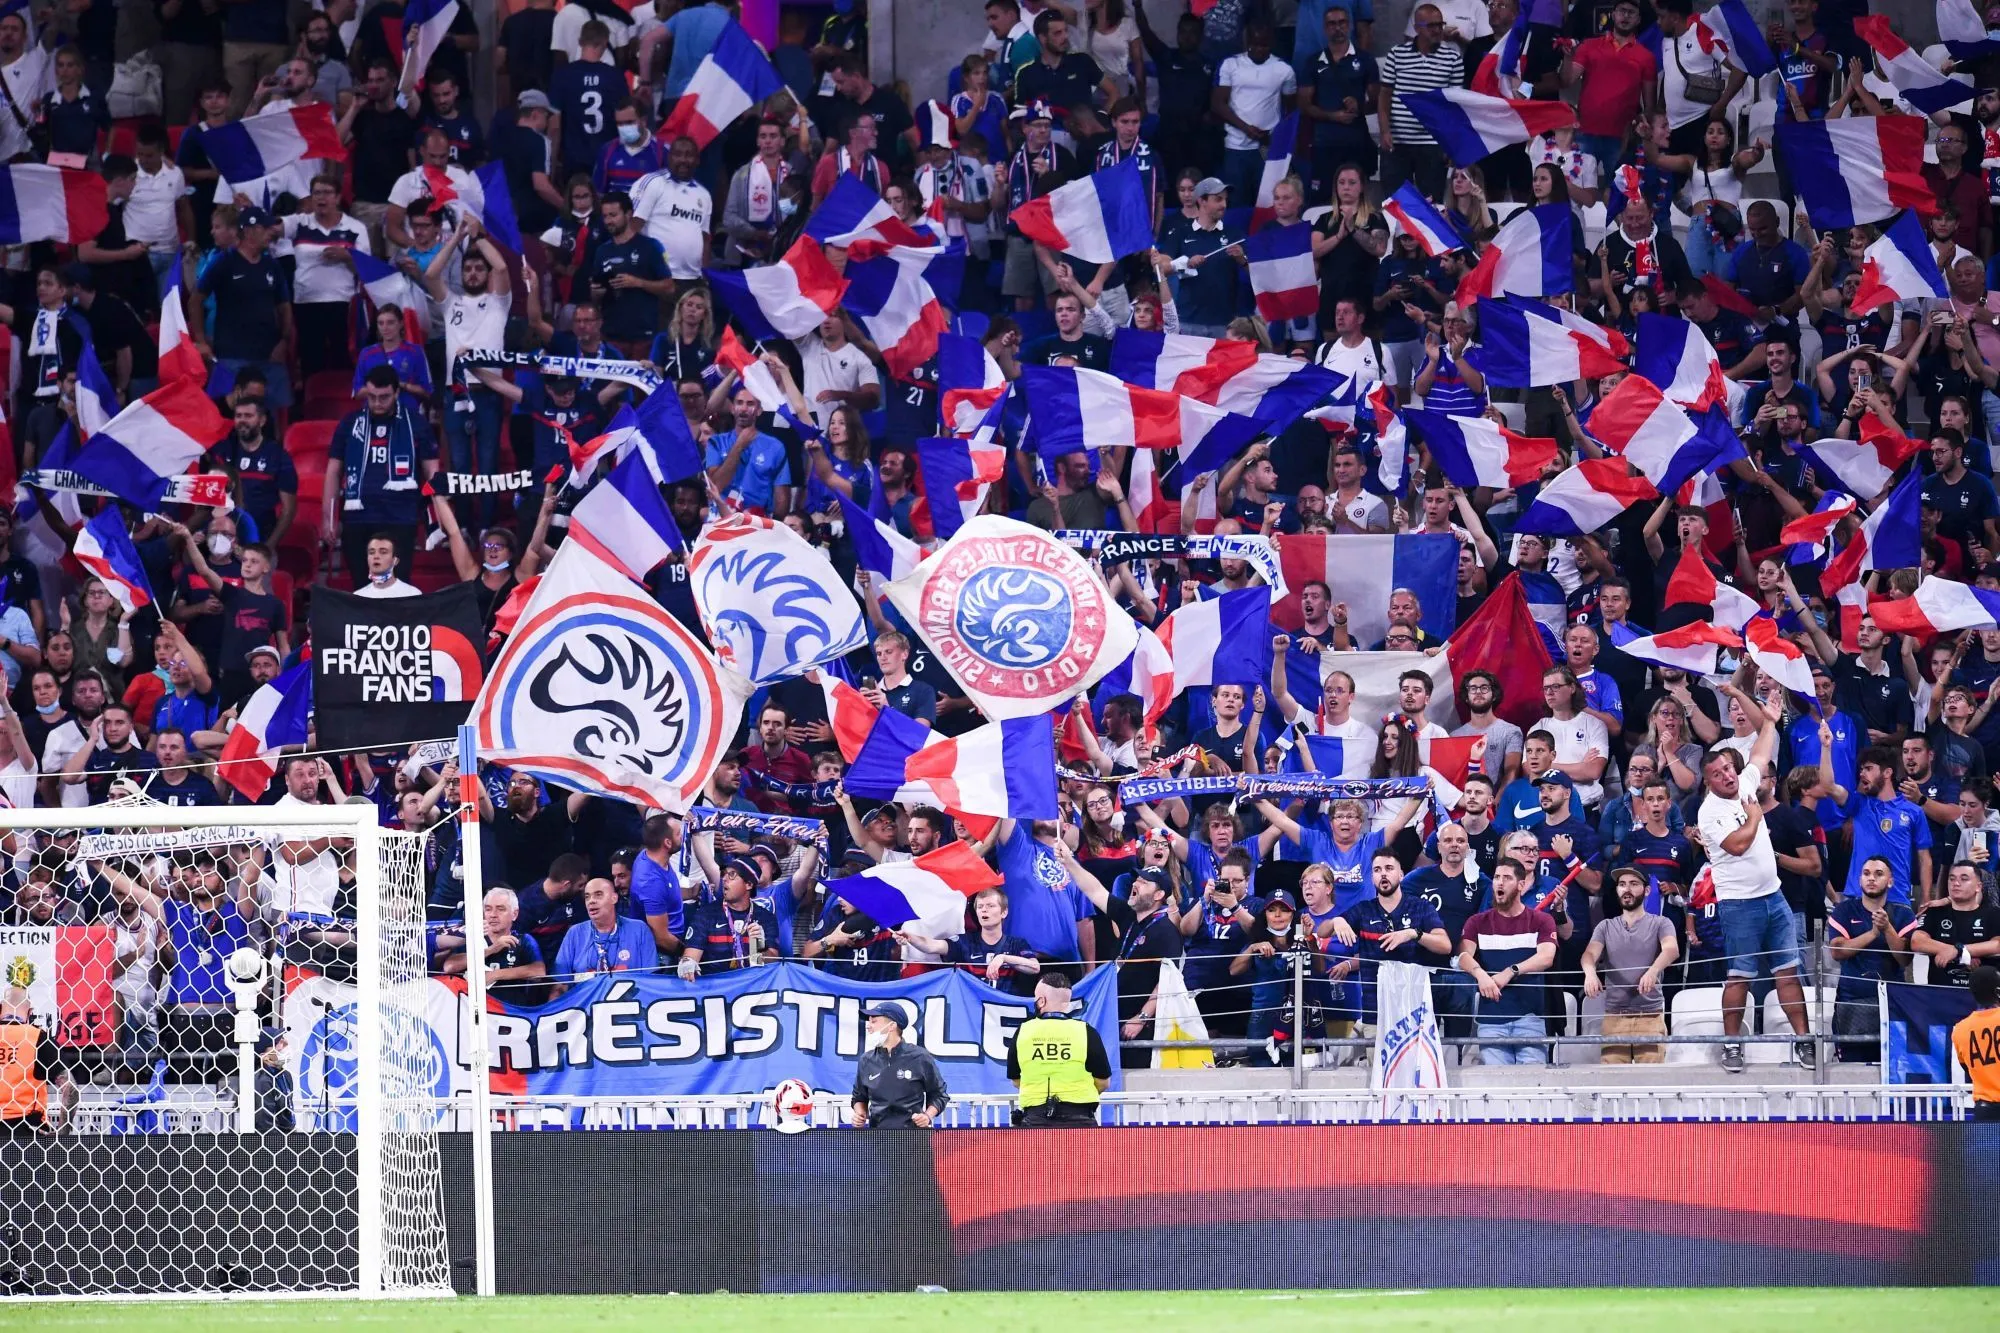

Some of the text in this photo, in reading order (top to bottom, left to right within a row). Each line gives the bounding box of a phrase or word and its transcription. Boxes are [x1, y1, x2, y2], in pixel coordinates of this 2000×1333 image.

[583, 75, 600, 86] FLO
[580, 90, 604, 134] 3
[670, 203, 703, 224] bwin
[459, 347, 529, 365] RANCE
[549, 355, 639, 377] FINLAND
[906, 386, 924, 407] 21
[1935, 382, 1944, 393] 7
[1361, 432, 1371, 443] 7
[371, 445, 387, 464] 19
[446, 469, 533, 494] FRANCE
[1066, 529, 1106, 541] FIN
[1098, 537, 1175, 563] FRANCE
[1195, 537, 1273, 567] FINLAND
[670, 563, 686, 583] 19
[344, 623, 431, 651] IF2010
[322, 648, 432, 676] FRANCE
[912, 655, 925, 673] 6
[362, 675, 432, 703] FANS
[437, 741, 455, 758] IR
[1123, 776, 1236, 800] RESISTIBLES
[1540, 858, 1550, 877] 6
[1704, 902, 1716, 918] 10
[0, 931, 51, 946] ECTION
[1213, 924, 1230, 940] 12
[852, 947, 868, 966] 19
[1031, 1043, 1072, 1061] AB6
